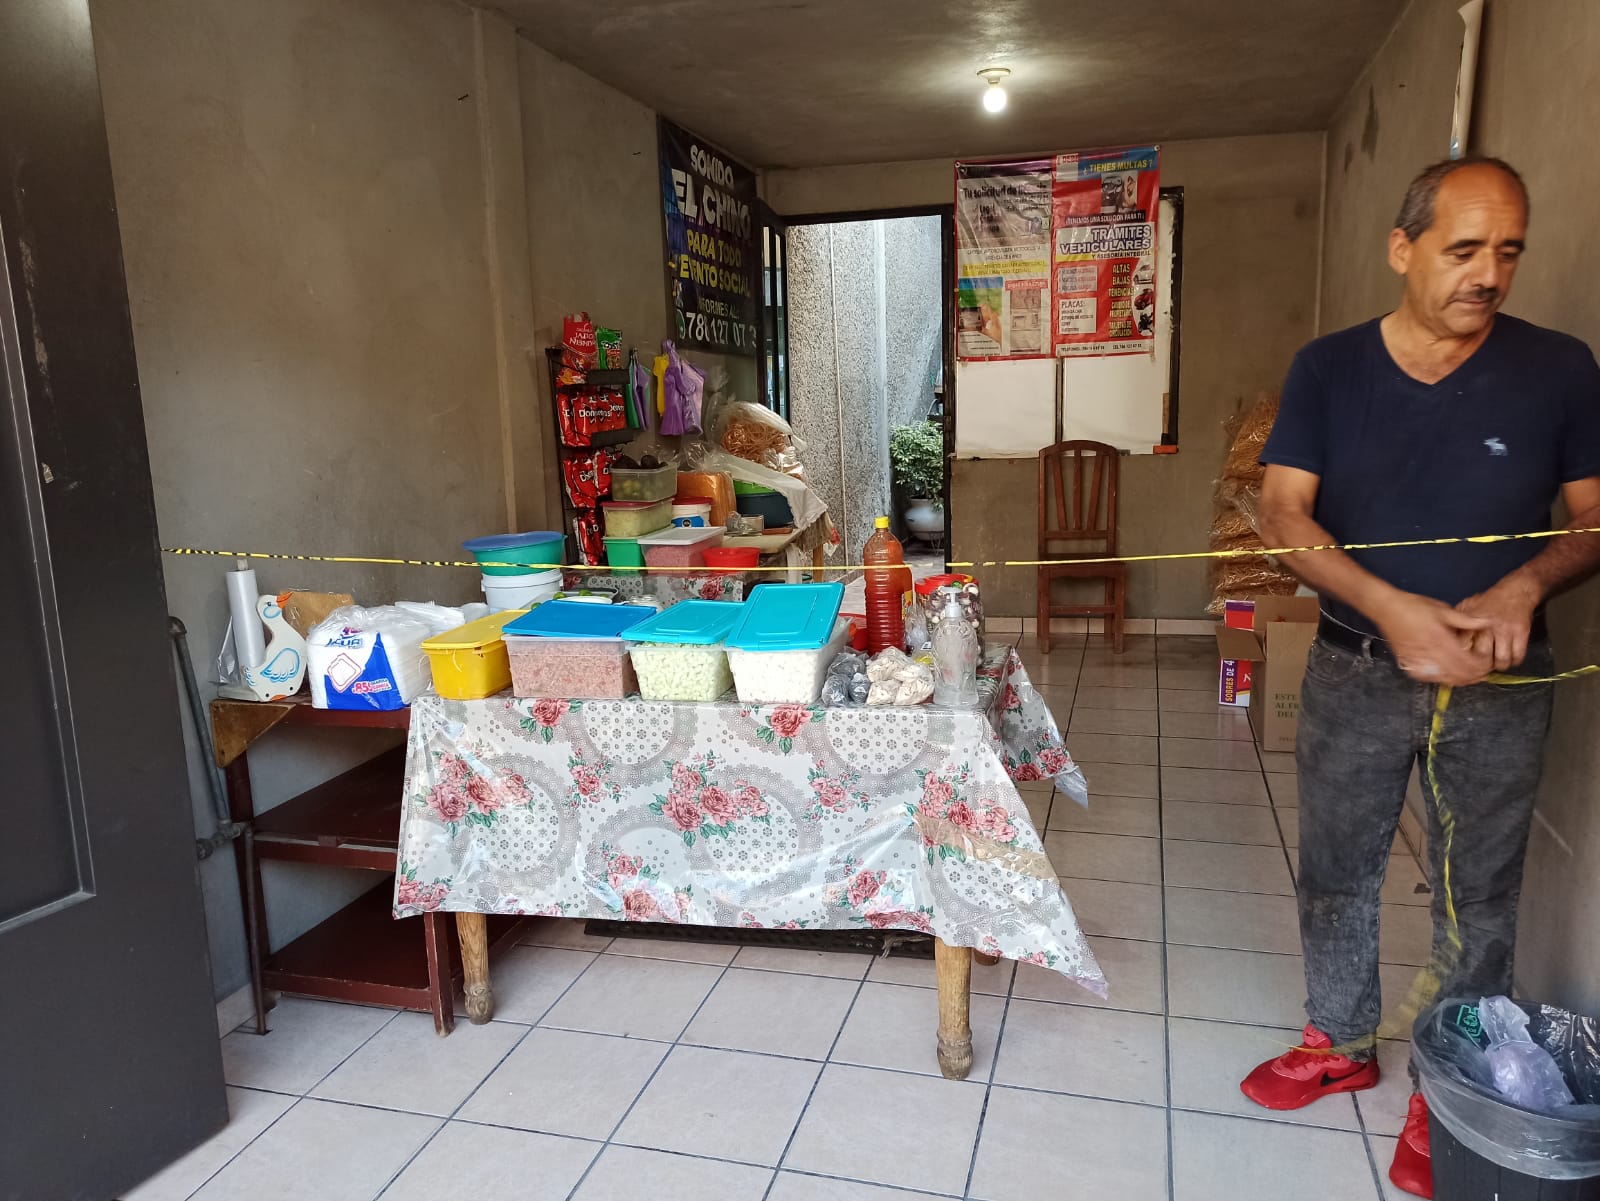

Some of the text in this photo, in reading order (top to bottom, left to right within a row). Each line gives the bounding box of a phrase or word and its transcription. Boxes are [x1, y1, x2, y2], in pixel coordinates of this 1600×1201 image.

[690, 144, 734, 189] SONIDO
[1089, 161, 1117, 173] TIENES
[1117, 159, 1148, 171] MULTAS
[671, 168, 752, 241] EL CHINO
[1092, 225, 1151, 241] TRÁMITES
[687, 229, 743, 269] PARA TODO
[1061, 240, 1150, 254] VEHICULARES
[1112, 263, 1131, 274] ALTAS
[719, 269, 752, 298] SOCIAL
[1112, 275, 1131, 286] BAJAS
[732, 321, 747, 348] 07
[1226, 667, 1234, 677] DE
[1225, 677, 1234, 702] SOBRES
